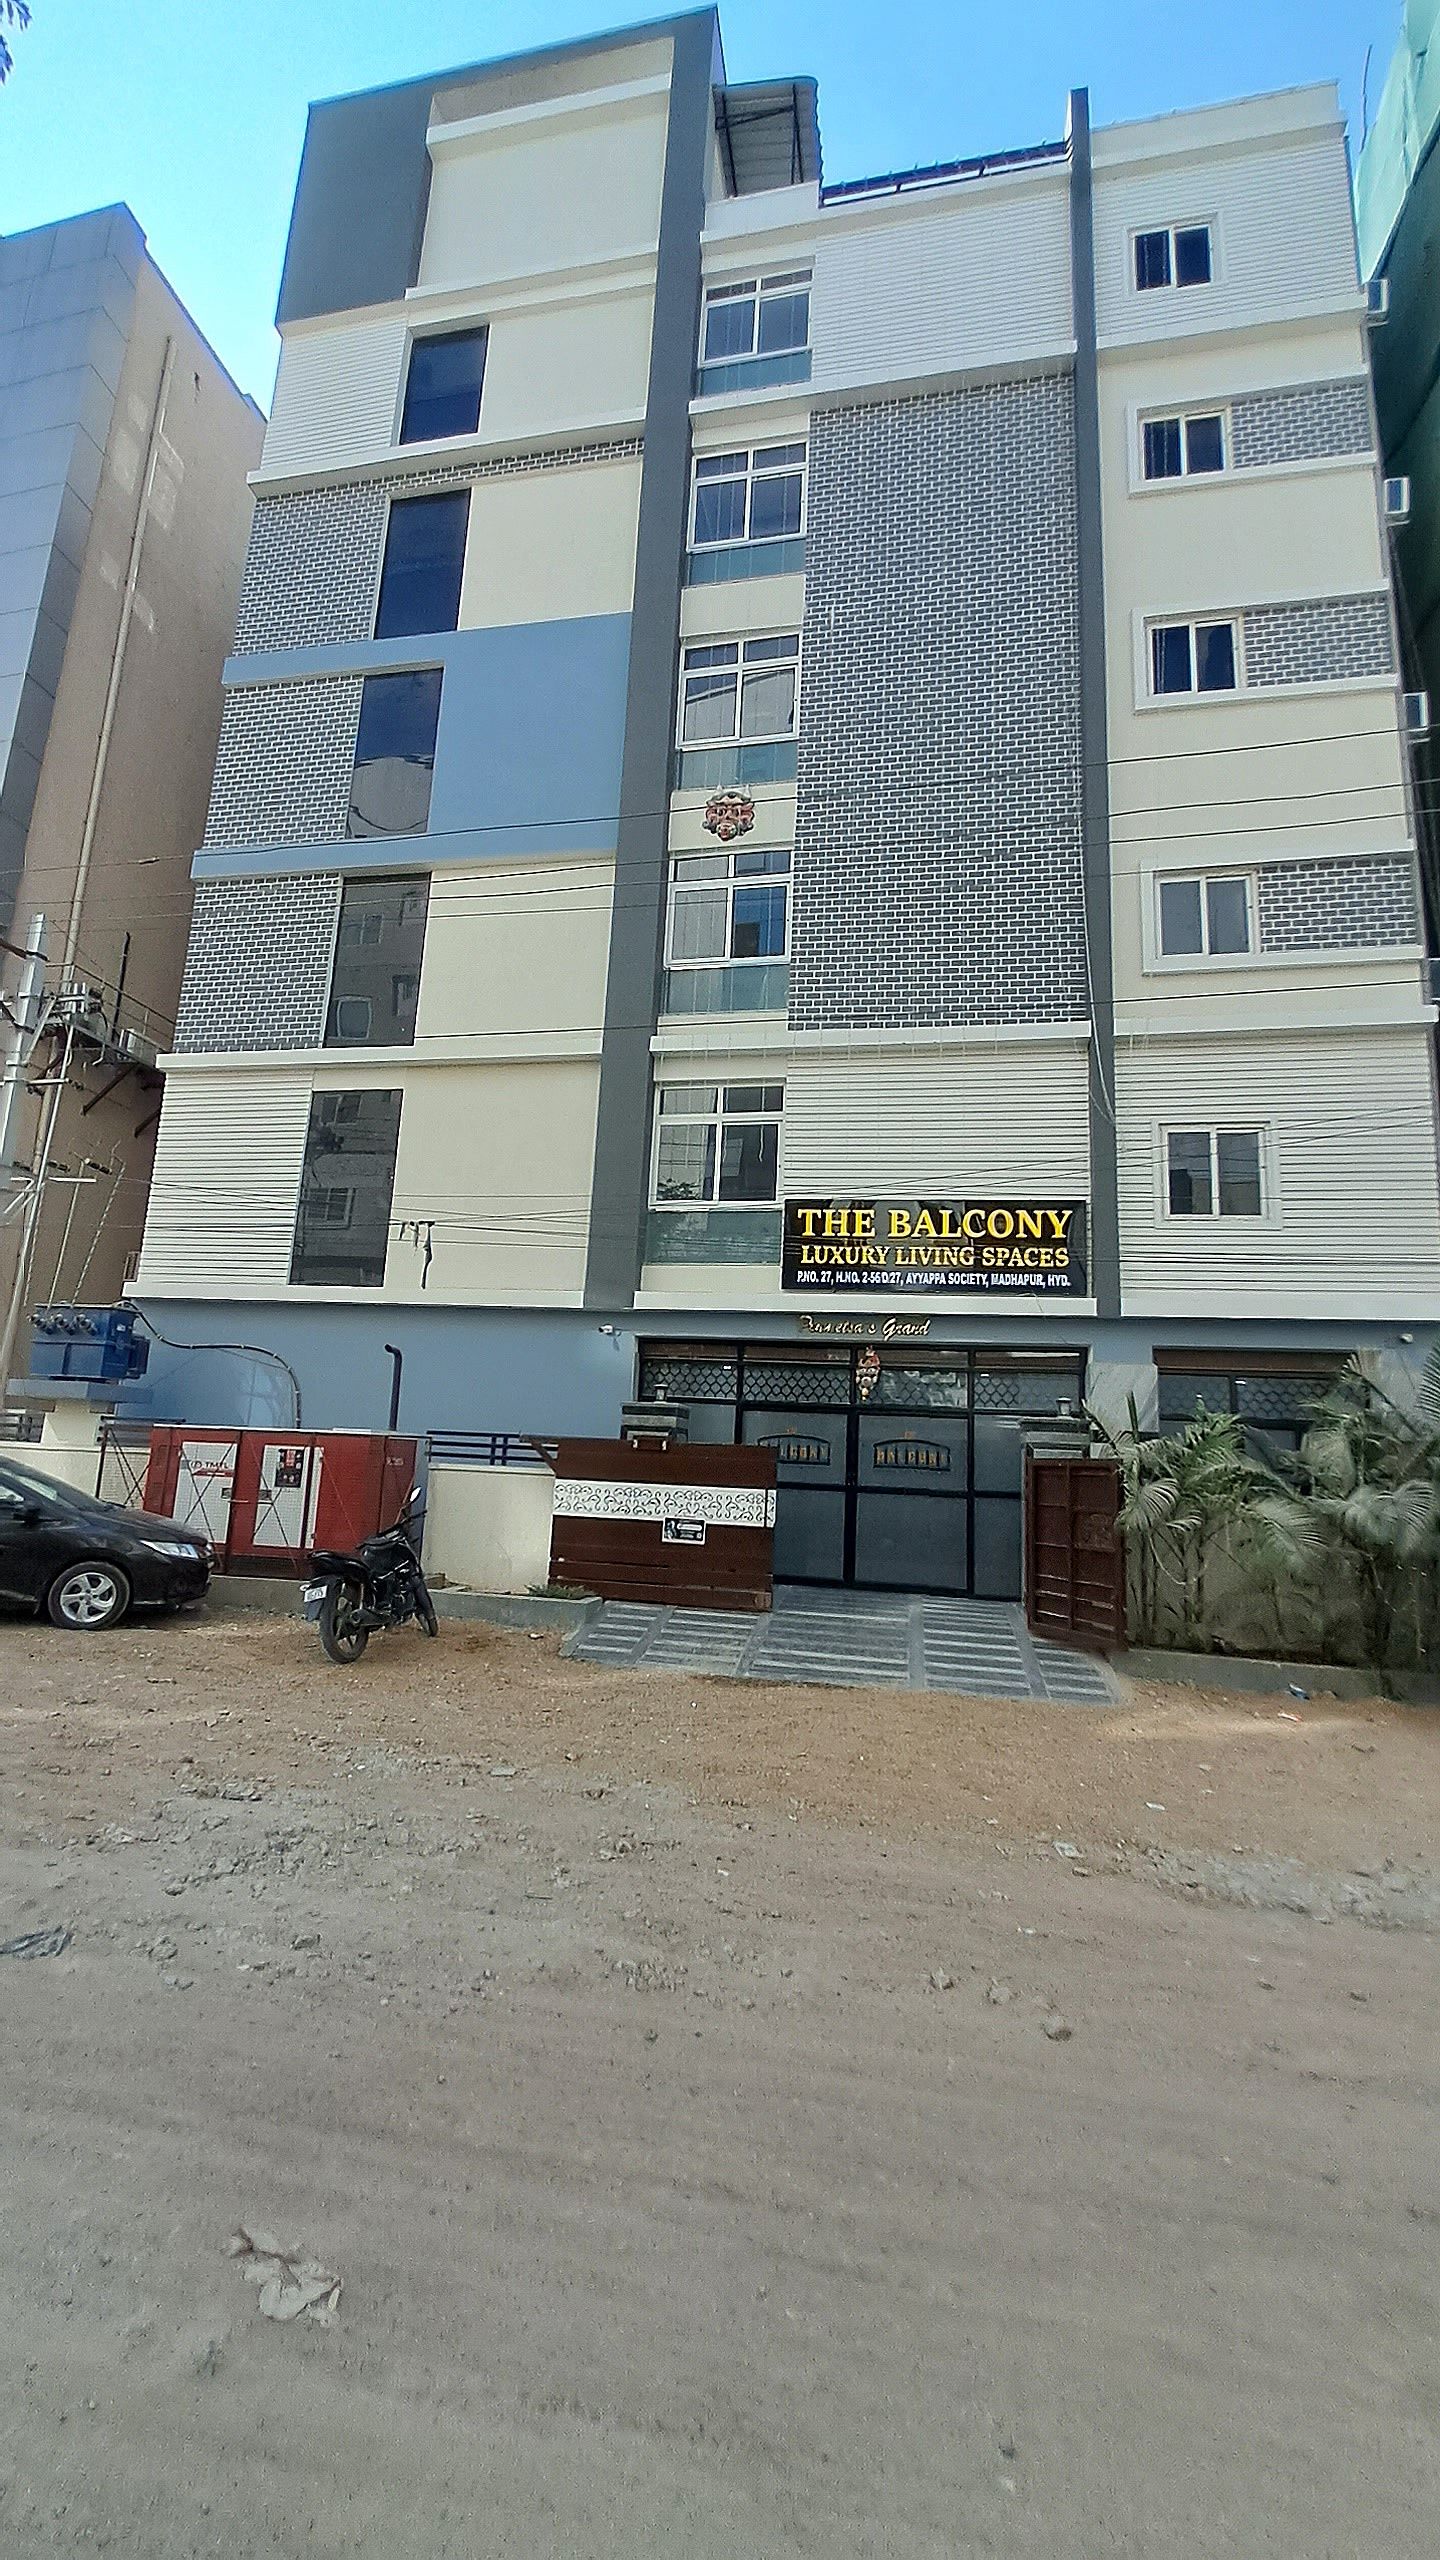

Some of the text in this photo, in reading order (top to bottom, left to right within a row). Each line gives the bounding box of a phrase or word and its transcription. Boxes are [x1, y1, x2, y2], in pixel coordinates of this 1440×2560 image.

[797, 1208, 1073, 1240] THE BALCONY
[800, 1245, 1070, 1268] LUXURY LIVING SPACES
[820, 1271, 834, 1286] 27,
[906, 1272, 946, 1285] AYYAPPA
[948, 1272, 989, 1288] SOCIETY,
[882, 1316, 931, 1341] Grand
